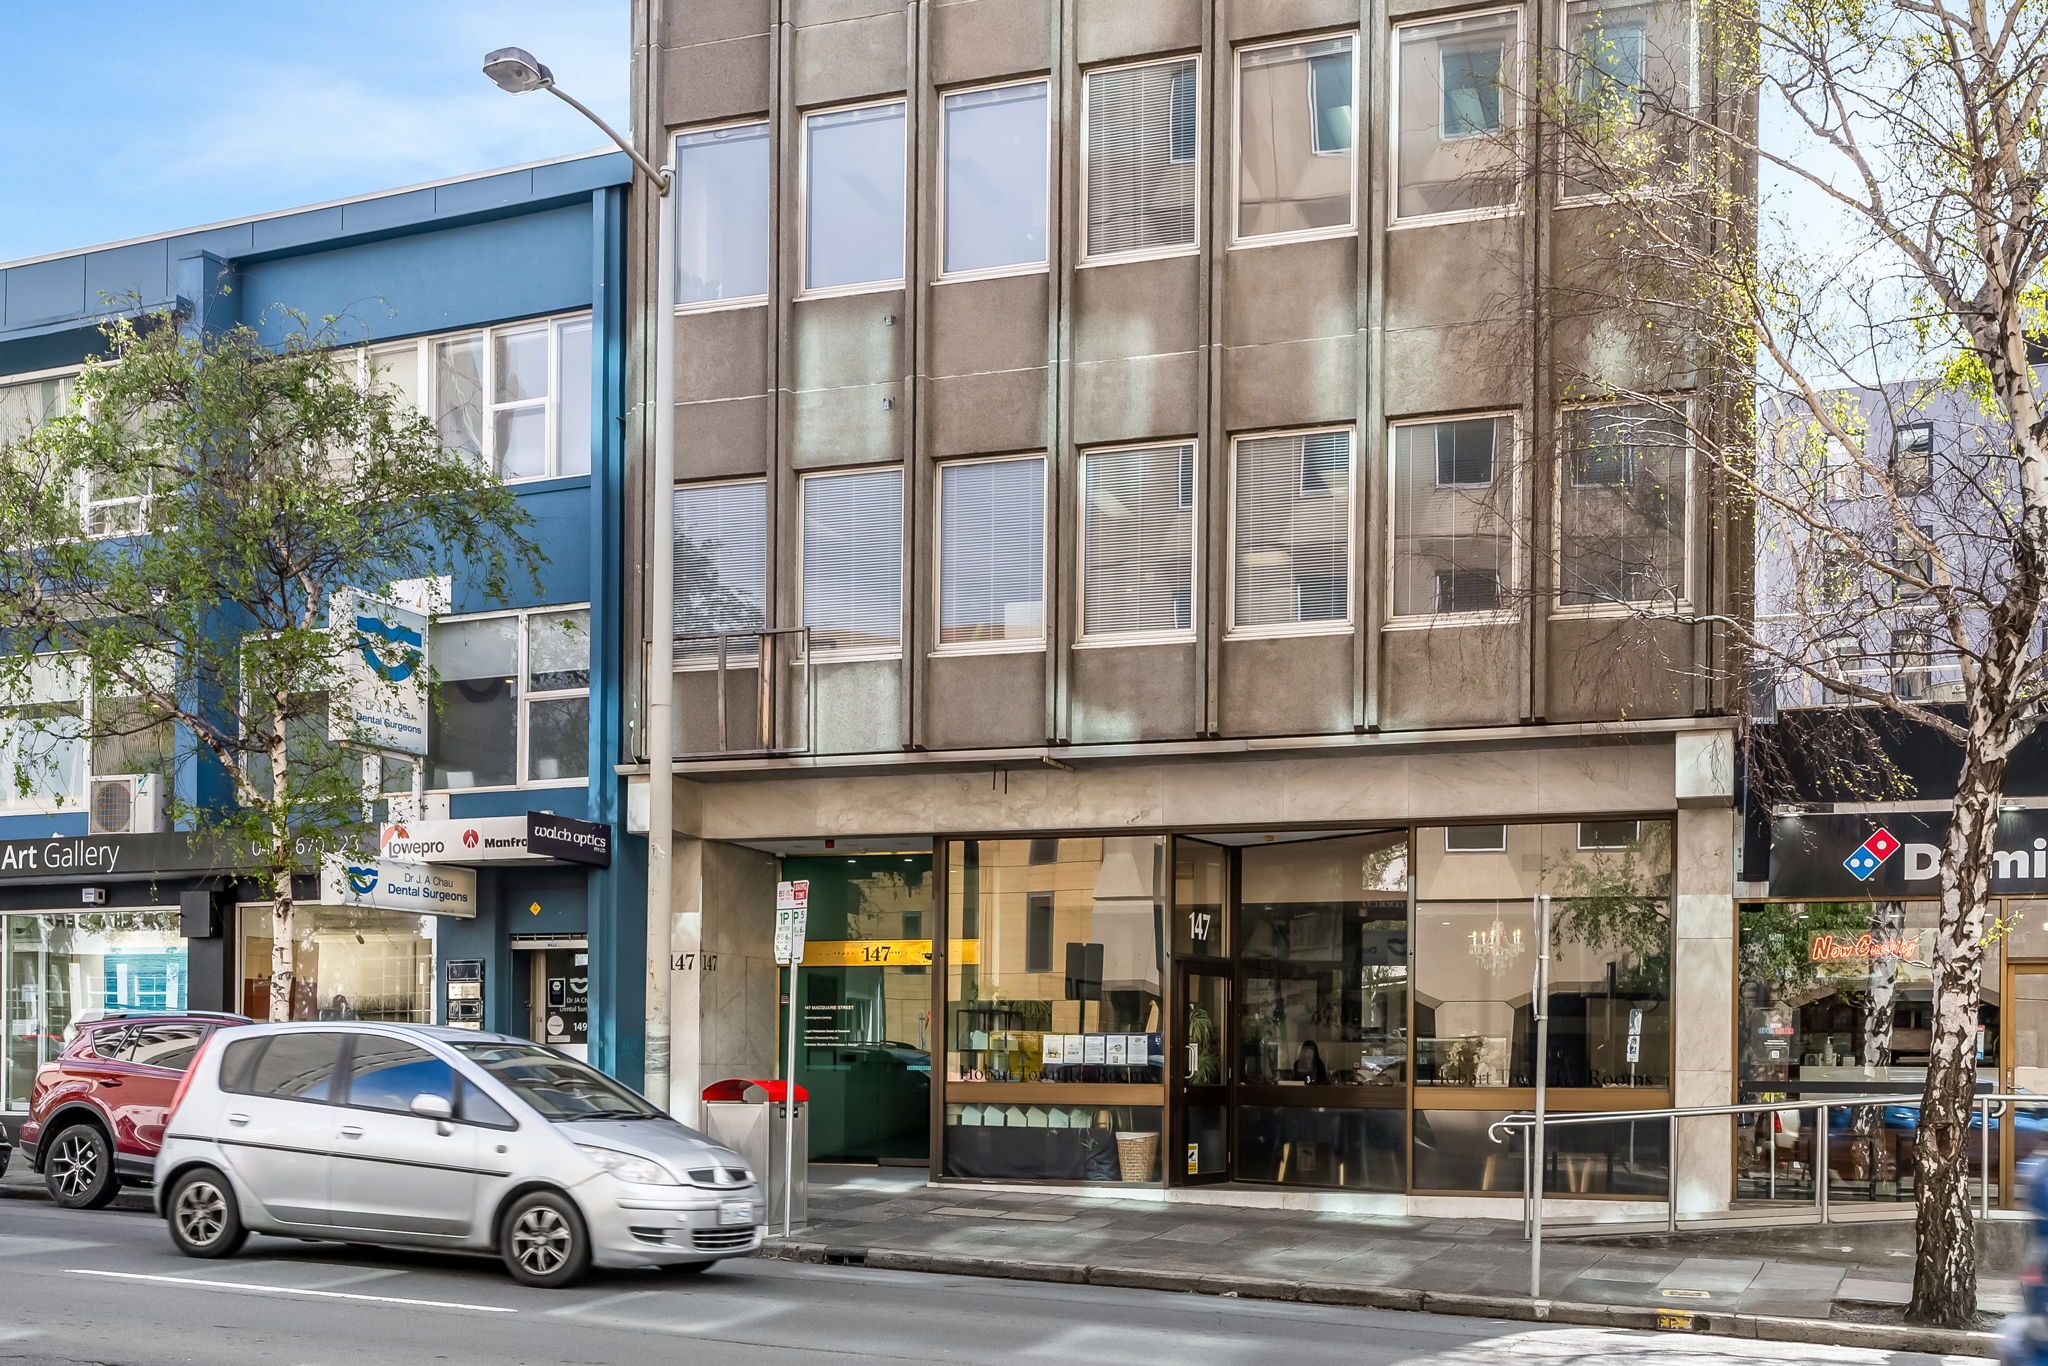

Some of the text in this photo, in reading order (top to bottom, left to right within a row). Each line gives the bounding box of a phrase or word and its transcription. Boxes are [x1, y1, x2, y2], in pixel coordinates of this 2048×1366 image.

[356, 709, 422, 735] Dental Surgeons
[484, 837, 528, 849] Manfro
[534, 825, 606, 848] walch optics
[1, 840, 120, 873] Art Gallery
[389, 840, 445, 858] Lowepro
[1904, 837, 2047, 881] Dmi
[404, 873, 414, 883] Dr
[424, 875, 431, 885] A
[433, 876, 454, 888] Chau
[388, 884, 468, 902] Dental Surgeons
[780, 912, 790, 925] 1P
[1189, 911, 1211, 940] 147
[863, 945, 892, 963] 147
[1811, 935, 1852, 961] Now
[670, 952, 696, 971] 147
[702, 953, 718, 972] 147
[573, 1022, 588, 1032] 149
[959, 1064, 1013, 1082] Hobart
[1017, 1065, 1061, 1082] Town
[1429, 1068, 1492, 1086] Hobart
[1588, 1068, 1654, 1087] Rooms
